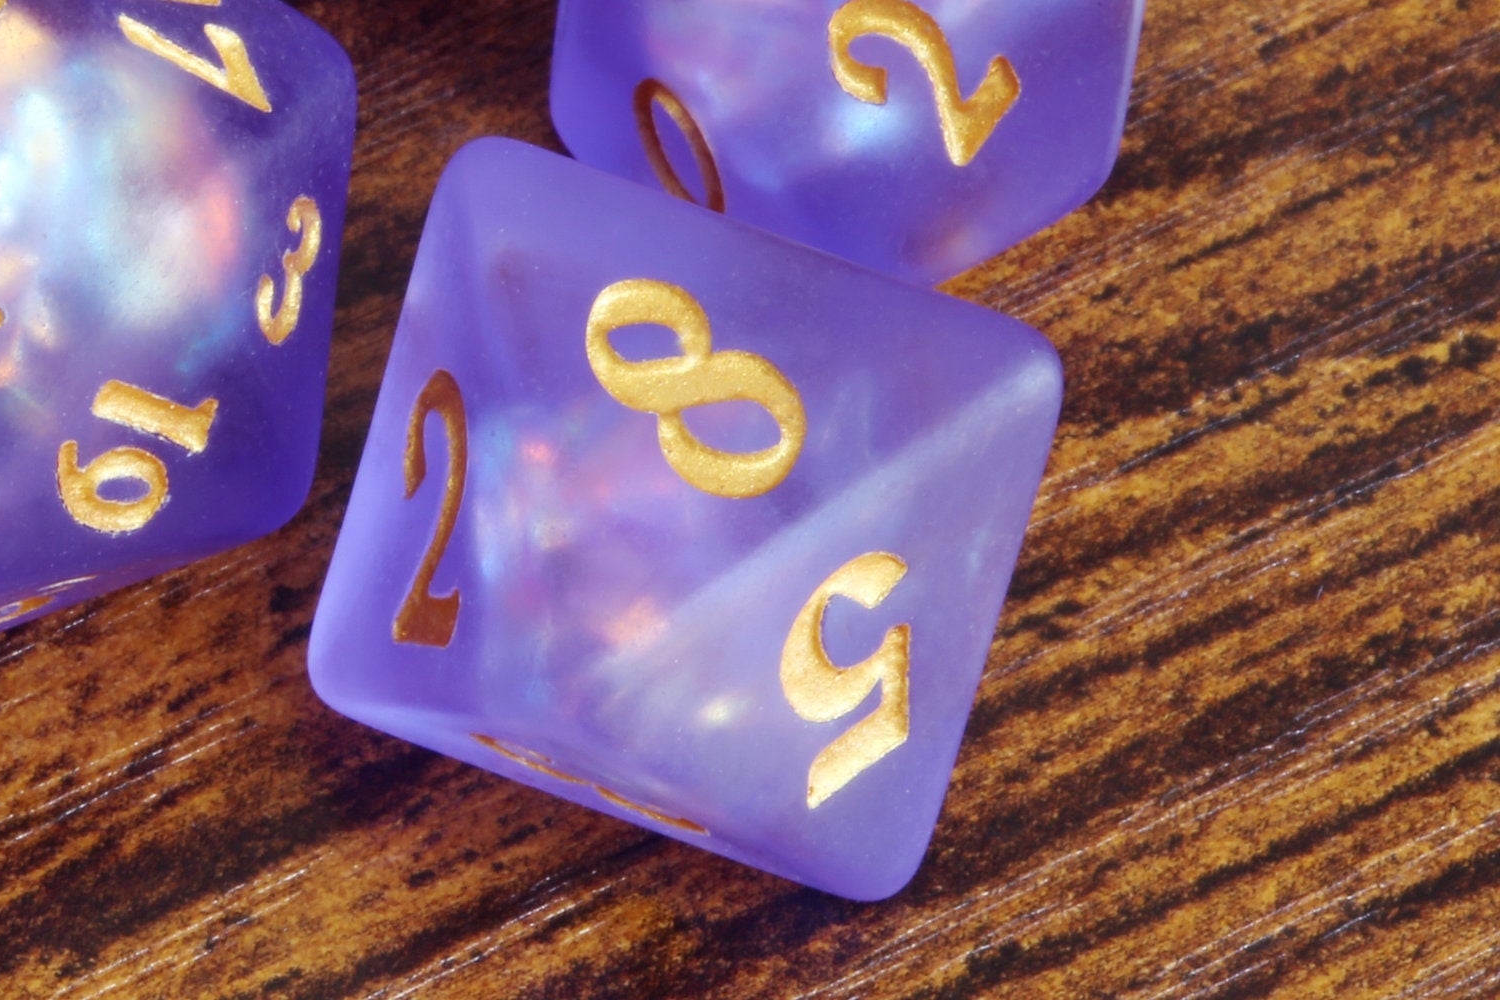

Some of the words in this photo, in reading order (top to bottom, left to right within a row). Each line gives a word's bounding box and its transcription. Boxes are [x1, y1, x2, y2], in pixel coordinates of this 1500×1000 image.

[256, 194, 322, 345] 3
[585, 278, 807, 499] 8
[393, 369, 468, 649] 2
[780, 550, 912, 810] 5
